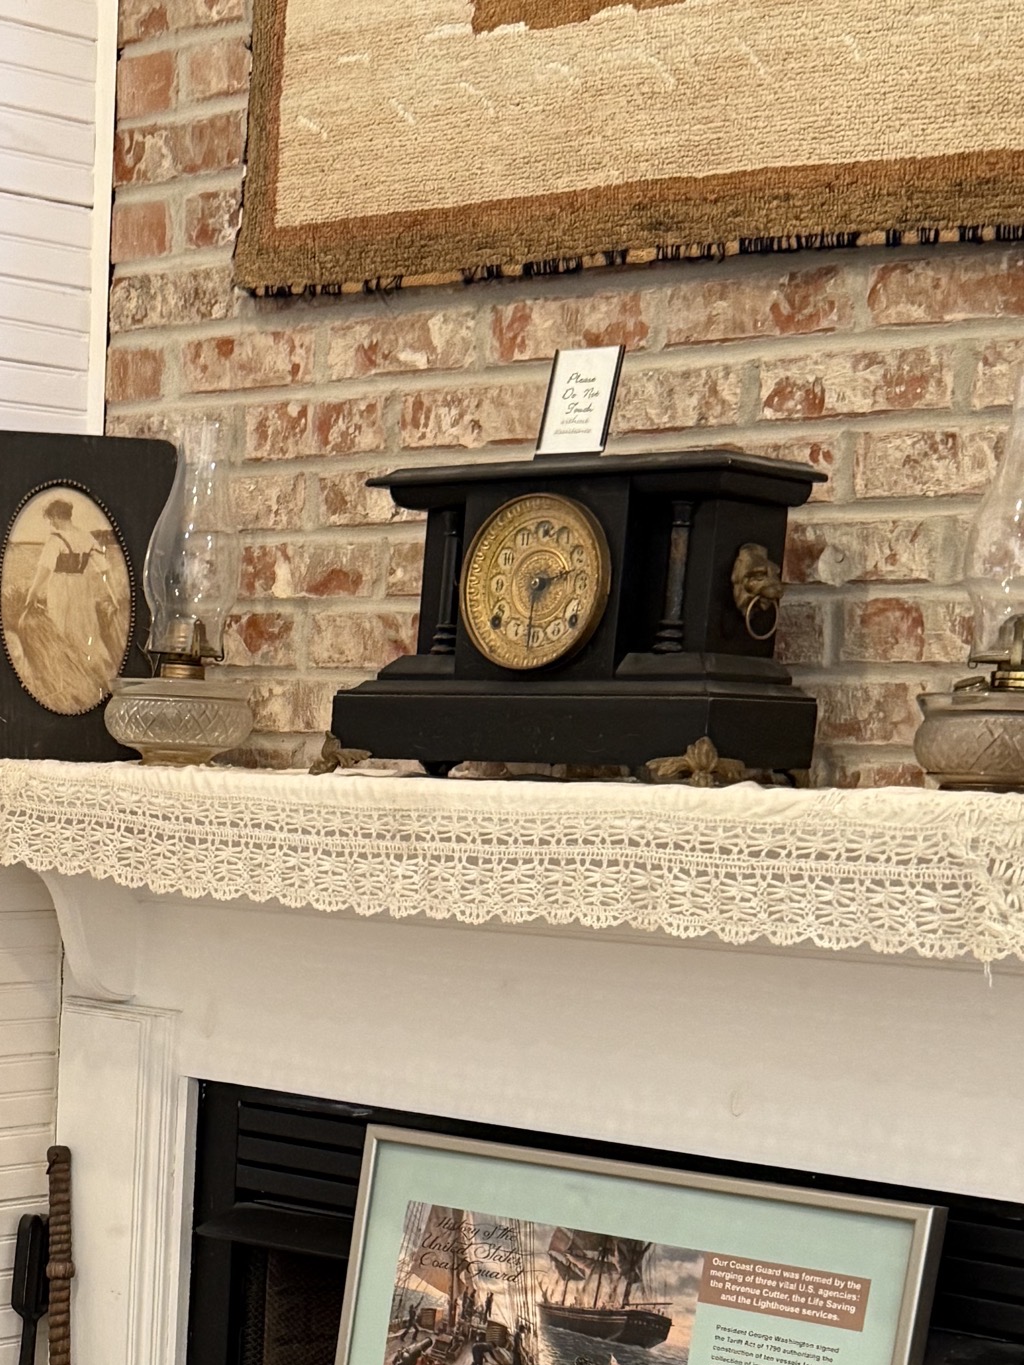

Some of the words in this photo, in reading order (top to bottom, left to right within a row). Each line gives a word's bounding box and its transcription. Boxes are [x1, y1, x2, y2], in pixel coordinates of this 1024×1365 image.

[567, 372, 596, 384] Please
[562, 388, 577, 400] Do
[583, 387, 600, 399] Not
[565, 402, 593, 415] Touch
[522, 532, 530, 546] 11
[504, 552, 514, 566] 10
[496, 581, 504, 593] 9
[513, 623, 521, 637] 7
[552, 622, 561, 634] 5
[483, 1226, 498, 1240] of
[421, 1232, 473, 1255] United
[419, 1251, 461, 1271] Coat
[466, 1260, 524, 1283] Guard
[711, 1256, 728, 1267] Our
[728, 1259, 754, 1272] Coast
[754, 1264, 781, 1276] Guard
[782, 1270, 800, 1280] was
[800, 1271, 833, 1285] formed
[833, 1277, 846, 1289] by
[846, 1280, 861, 1290] the
[709, 1269, 743, 1283] merging
[744, 1274, 754, 1283] of
[754, 1275, 777, 1287] three
[778, 1280, 797, 1290] vital
[798, 1282, 815, 1294] U.S.
[817, 1288, 860, 1301] agencies:
[709, 1279, 723, 1288] the
[724, 1281, 761, 1295] Revenue
[761, 1288, 790, 1301] Cutter,
[791, 1293, 806, 1303] the
[806, 1296, 824, 1307] Life
[825, 1299, 856, 1314] Saving
[719, 1293, 736, 1302] and
[736, 1294, 751, 1305] the
[752, 1297, 800, 1314] Lighthouse
[801, 1307, 840, 1321] services.
